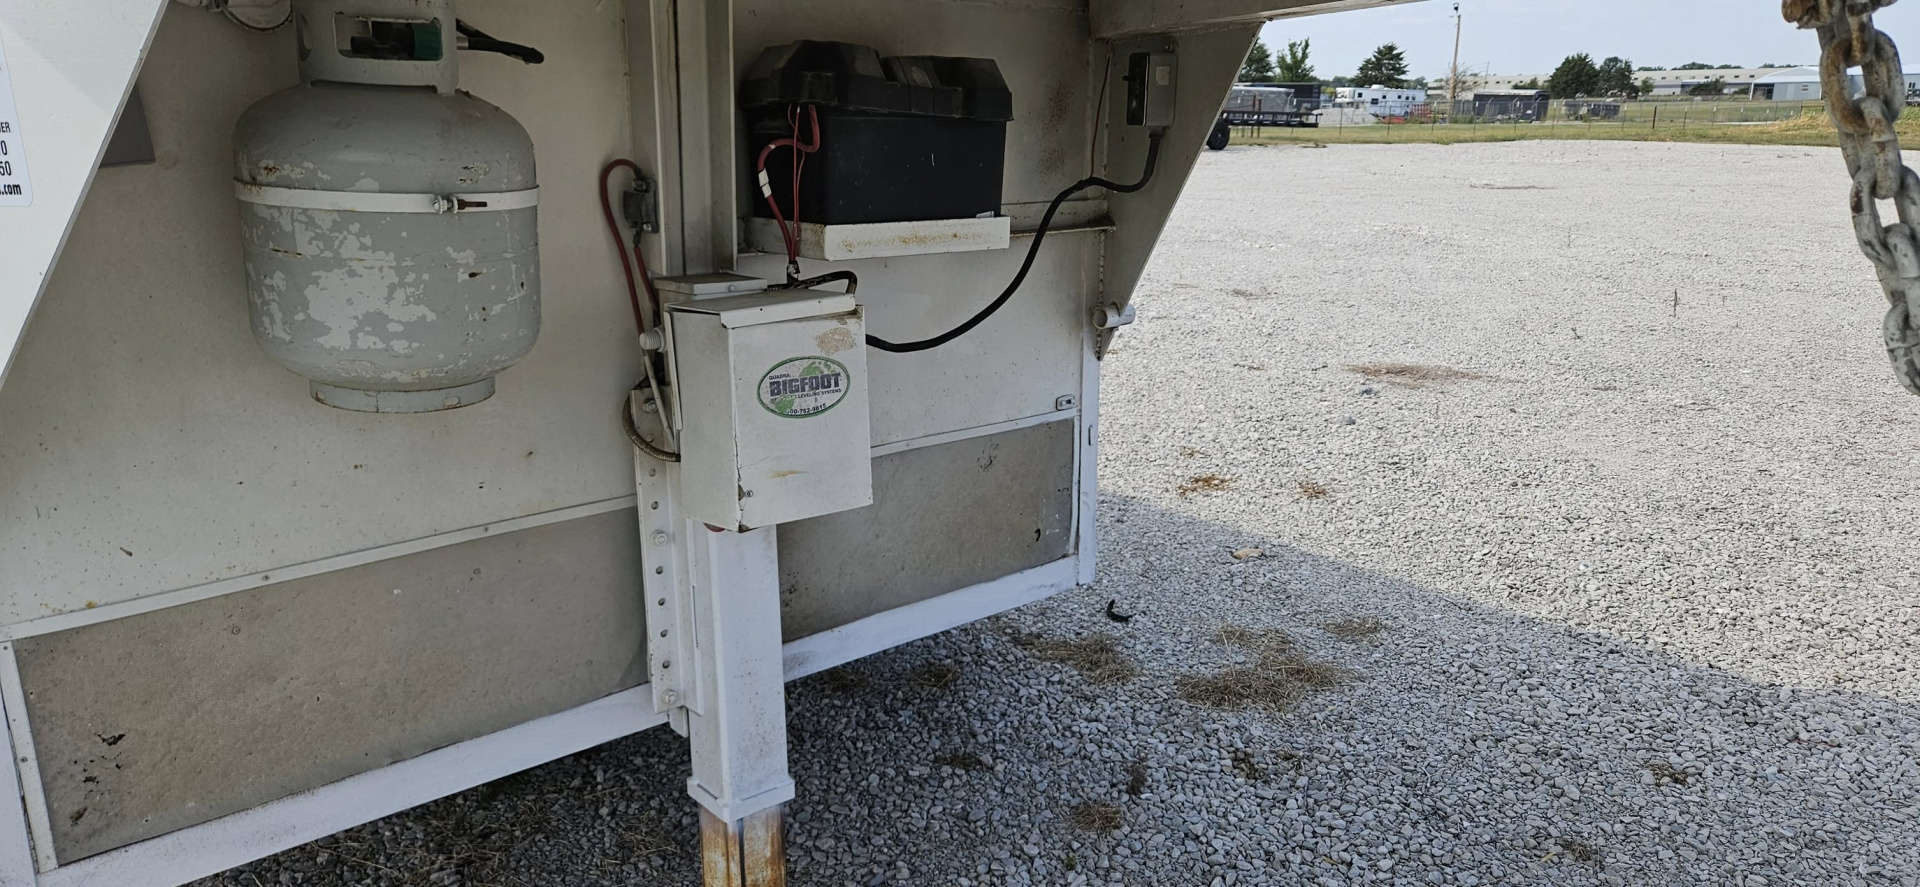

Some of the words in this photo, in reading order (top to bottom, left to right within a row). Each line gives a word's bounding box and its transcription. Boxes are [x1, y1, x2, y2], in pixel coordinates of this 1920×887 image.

[0, 121, 11, 133] ER
[0, 140, 7, 156] 0
[0, 184, 22, 195] .com
[769, 373, 841, 397] BIGFOOT
[798, 391, 820, 399] LEVELING
